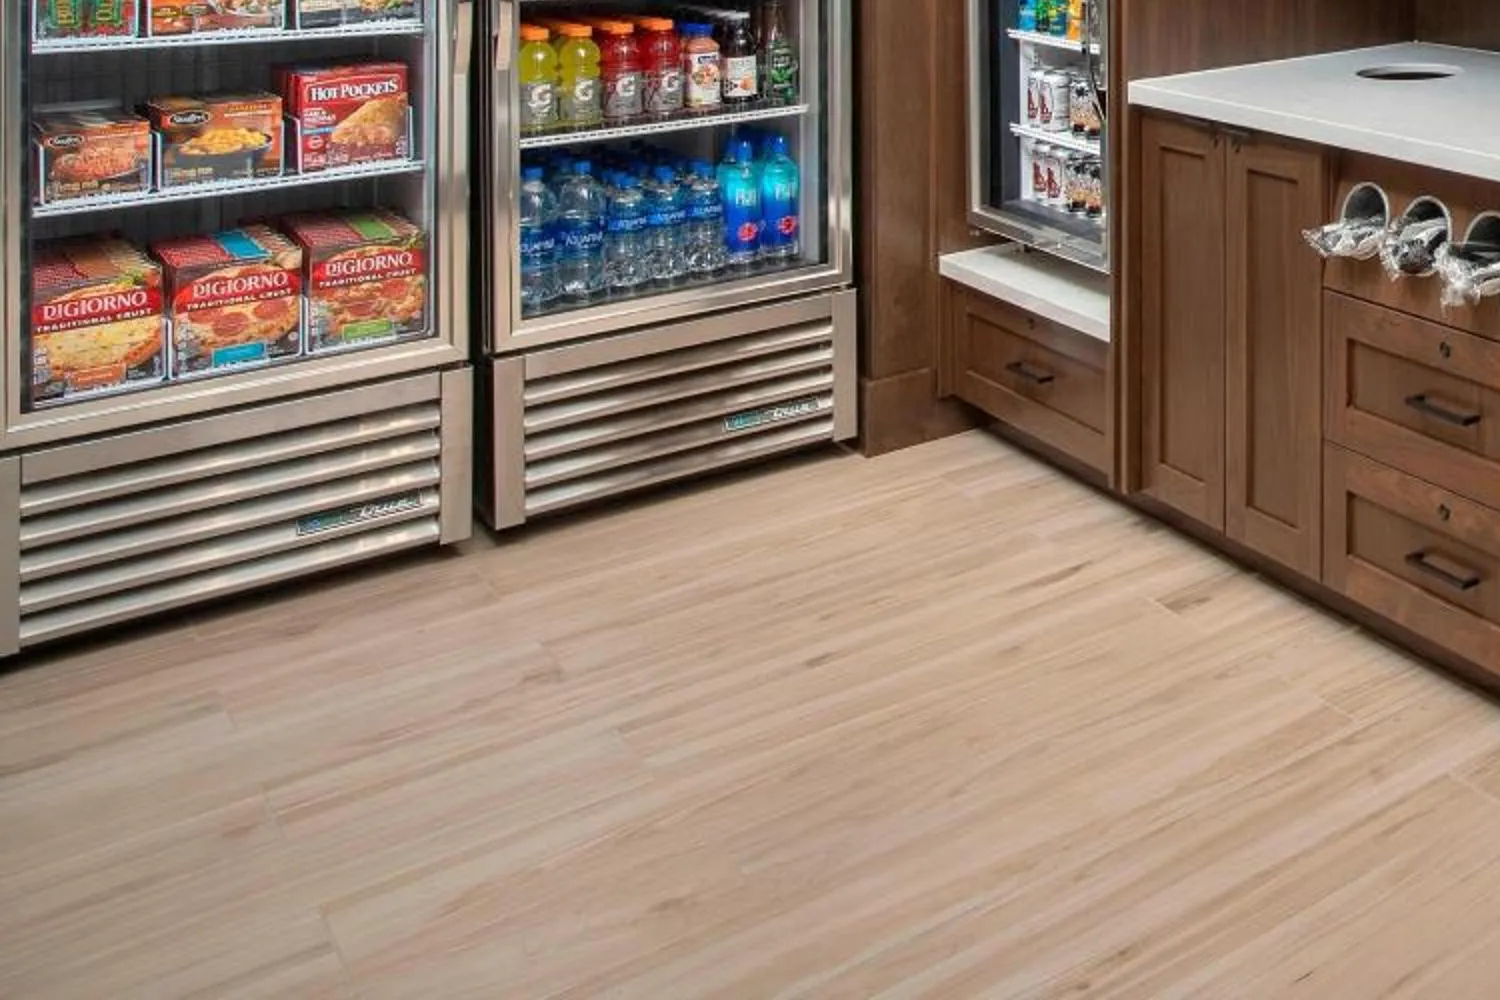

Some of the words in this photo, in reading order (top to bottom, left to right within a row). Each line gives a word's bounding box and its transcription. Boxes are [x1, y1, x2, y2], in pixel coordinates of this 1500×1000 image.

[311, 87, 337, 101] HOT
[340, 80, 398, 97] POCKETS
[325, 252, 413, 277] DIGIORNO
[192, 272, 288, 299] DIGIORNO
[43, 291, 148, 321] DIGIORNO
